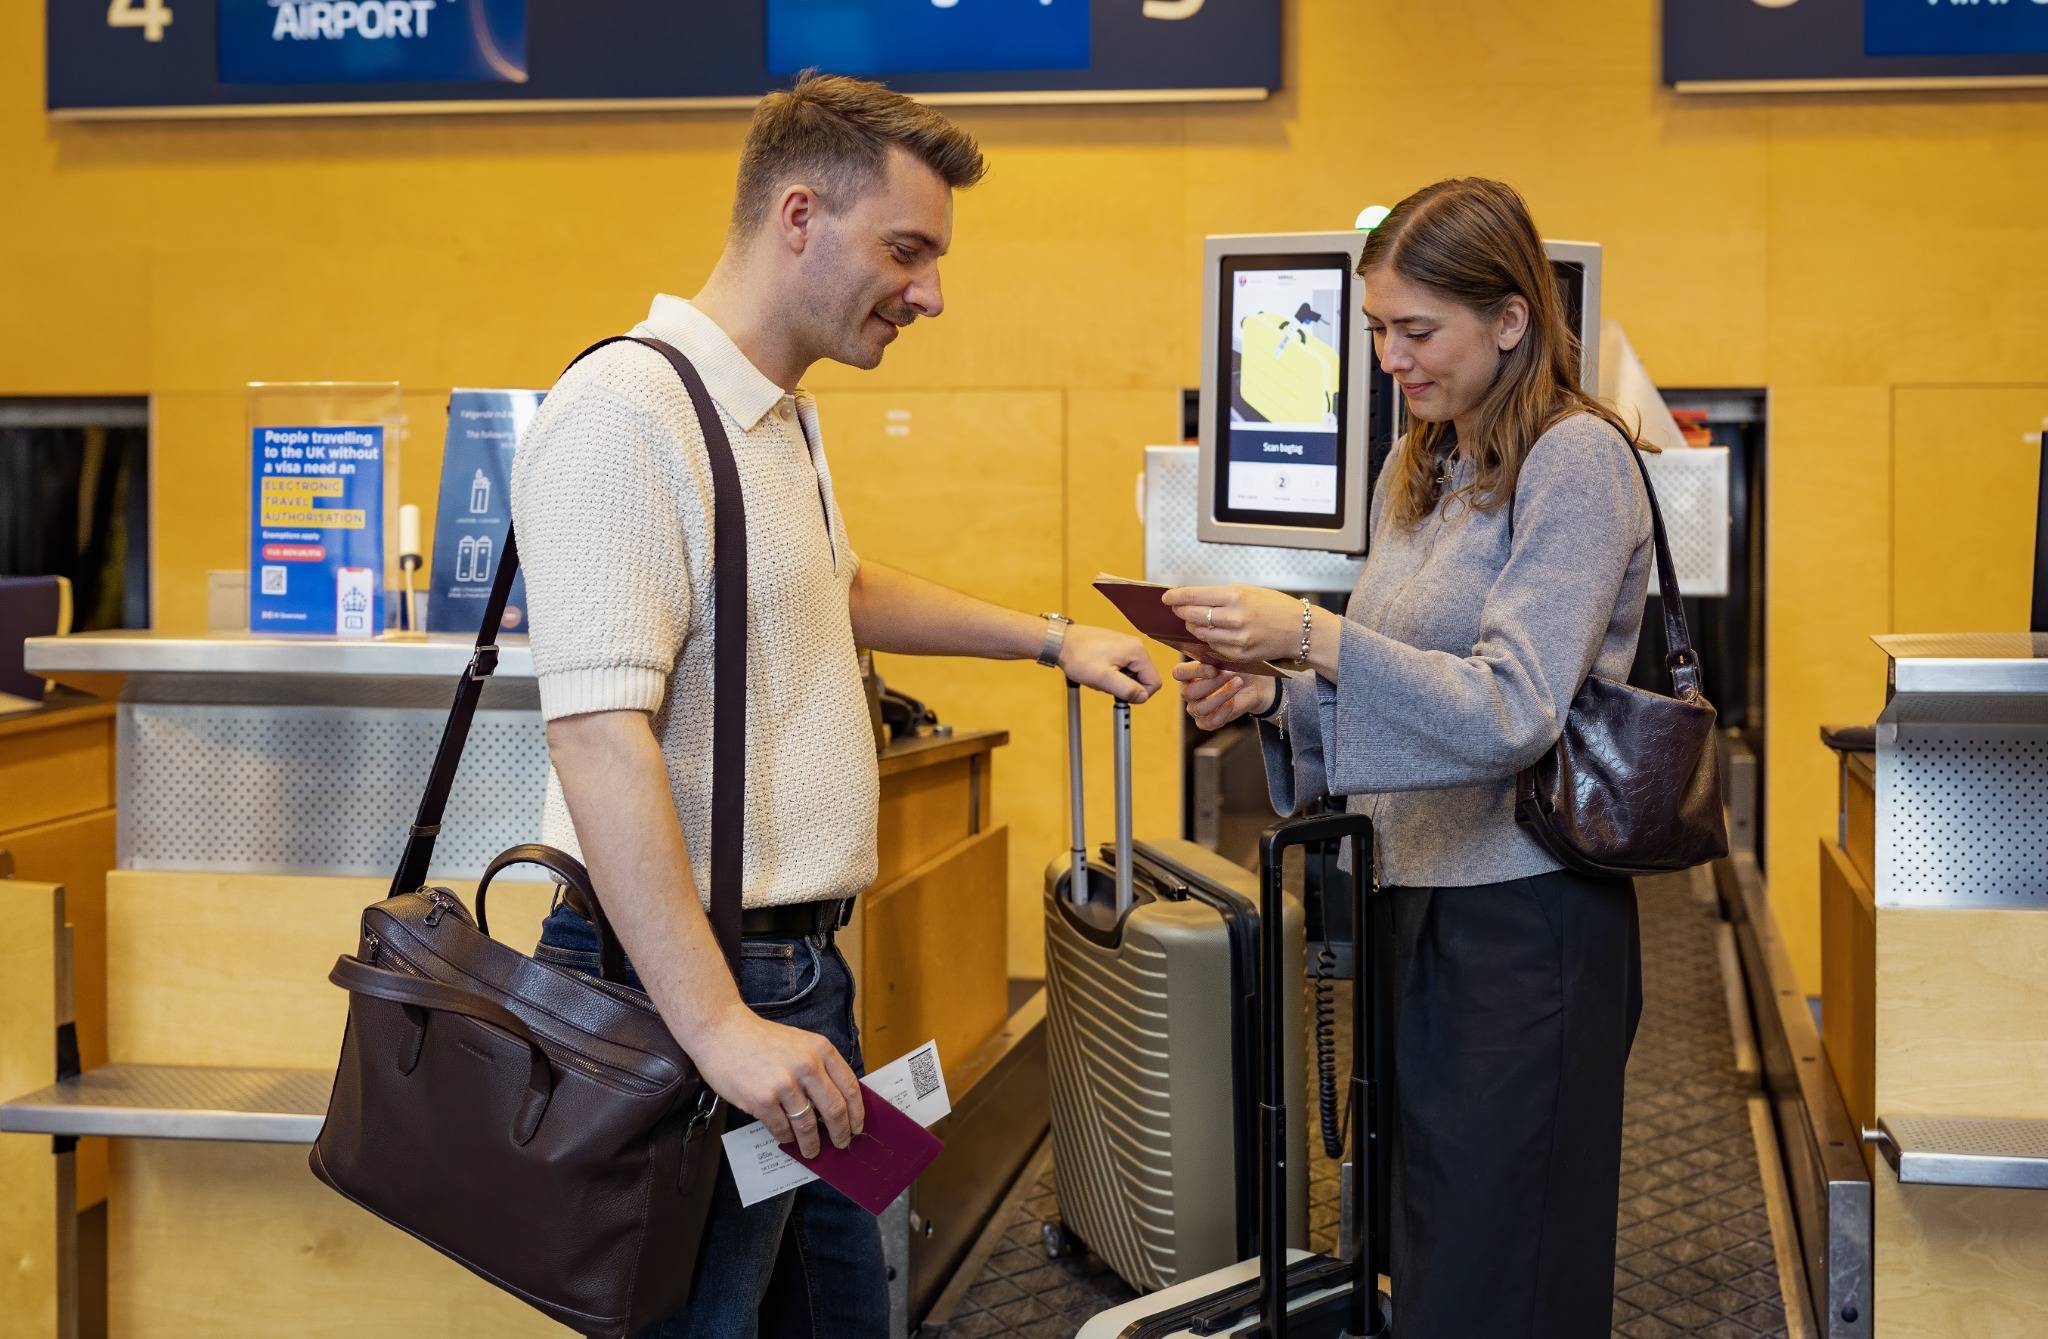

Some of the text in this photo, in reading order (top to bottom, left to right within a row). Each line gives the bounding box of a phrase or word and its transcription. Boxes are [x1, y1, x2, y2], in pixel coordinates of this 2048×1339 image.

[107, 0, 173, 42] 4
[272, 0, 437, 40] AIRPORT
[265, 430, 373, 447] People travelling
[264, 445, 379, 460] to the UK without
[1262, 442, 1279, 452] Scan
[264, 460, 356, 475] a visa need an
[264, 481, 339, 492] ELECTRONIC
[1278, 476, 1286, 488] 2
[264, 496, 309, 506] TRAVEL
[264, 511, 362, 523] AUTHORISATION
